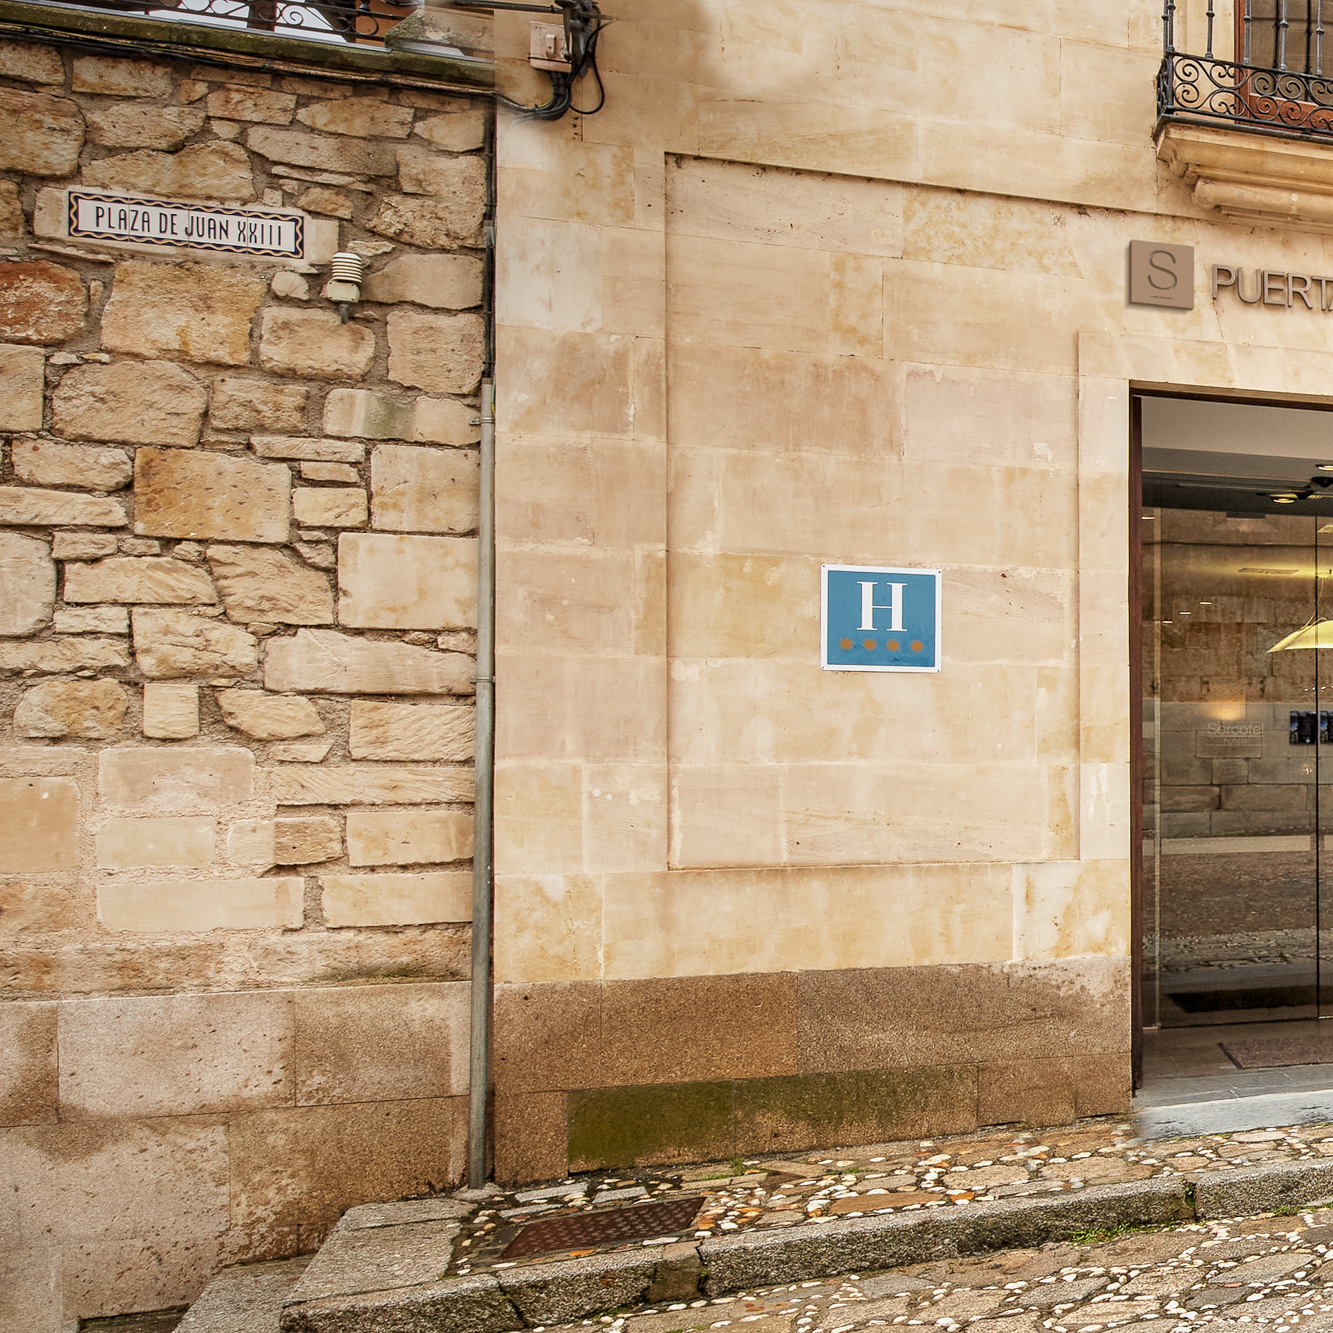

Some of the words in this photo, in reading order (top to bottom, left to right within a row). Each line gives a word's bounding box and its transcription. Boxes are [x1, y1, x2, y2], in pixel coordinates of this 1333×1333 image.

[95, 206, 151, 232] PLAZA
[159, 212, 178, 235] DE
[185, 216, 229, 240] JUAN
[237, 221, 282, 246] XXIII
[1147, 249, 1178, 291] S
[856, 581, 908, 632] H
[1207, 722, 1264, 735] Sercotel
